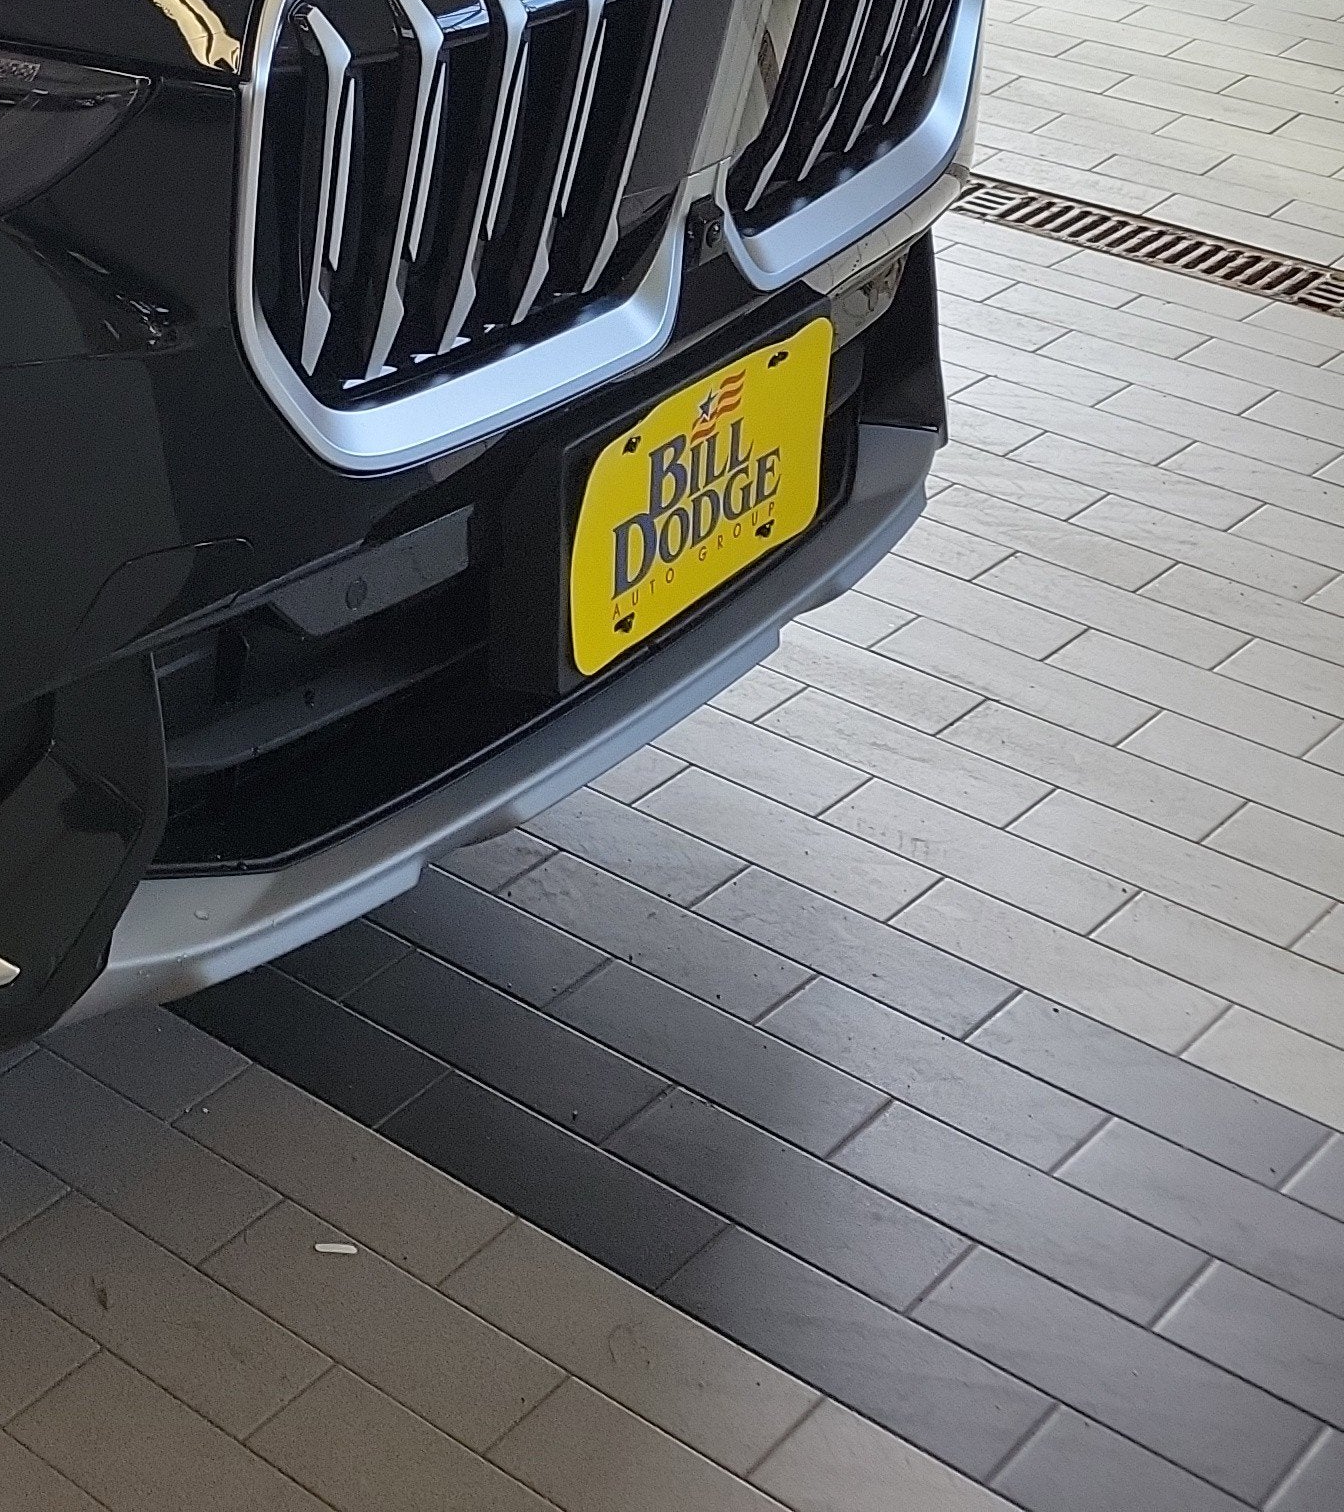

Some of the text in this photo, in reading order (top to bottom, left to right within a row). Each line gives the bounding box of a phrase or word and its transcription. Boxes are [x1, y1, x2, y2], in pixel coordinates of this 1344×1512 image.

[612, 446, 782, 600] DODGE
[648, 417, 754, 519] BILL
[612, 501, 775, 620] AUTO GROUP
